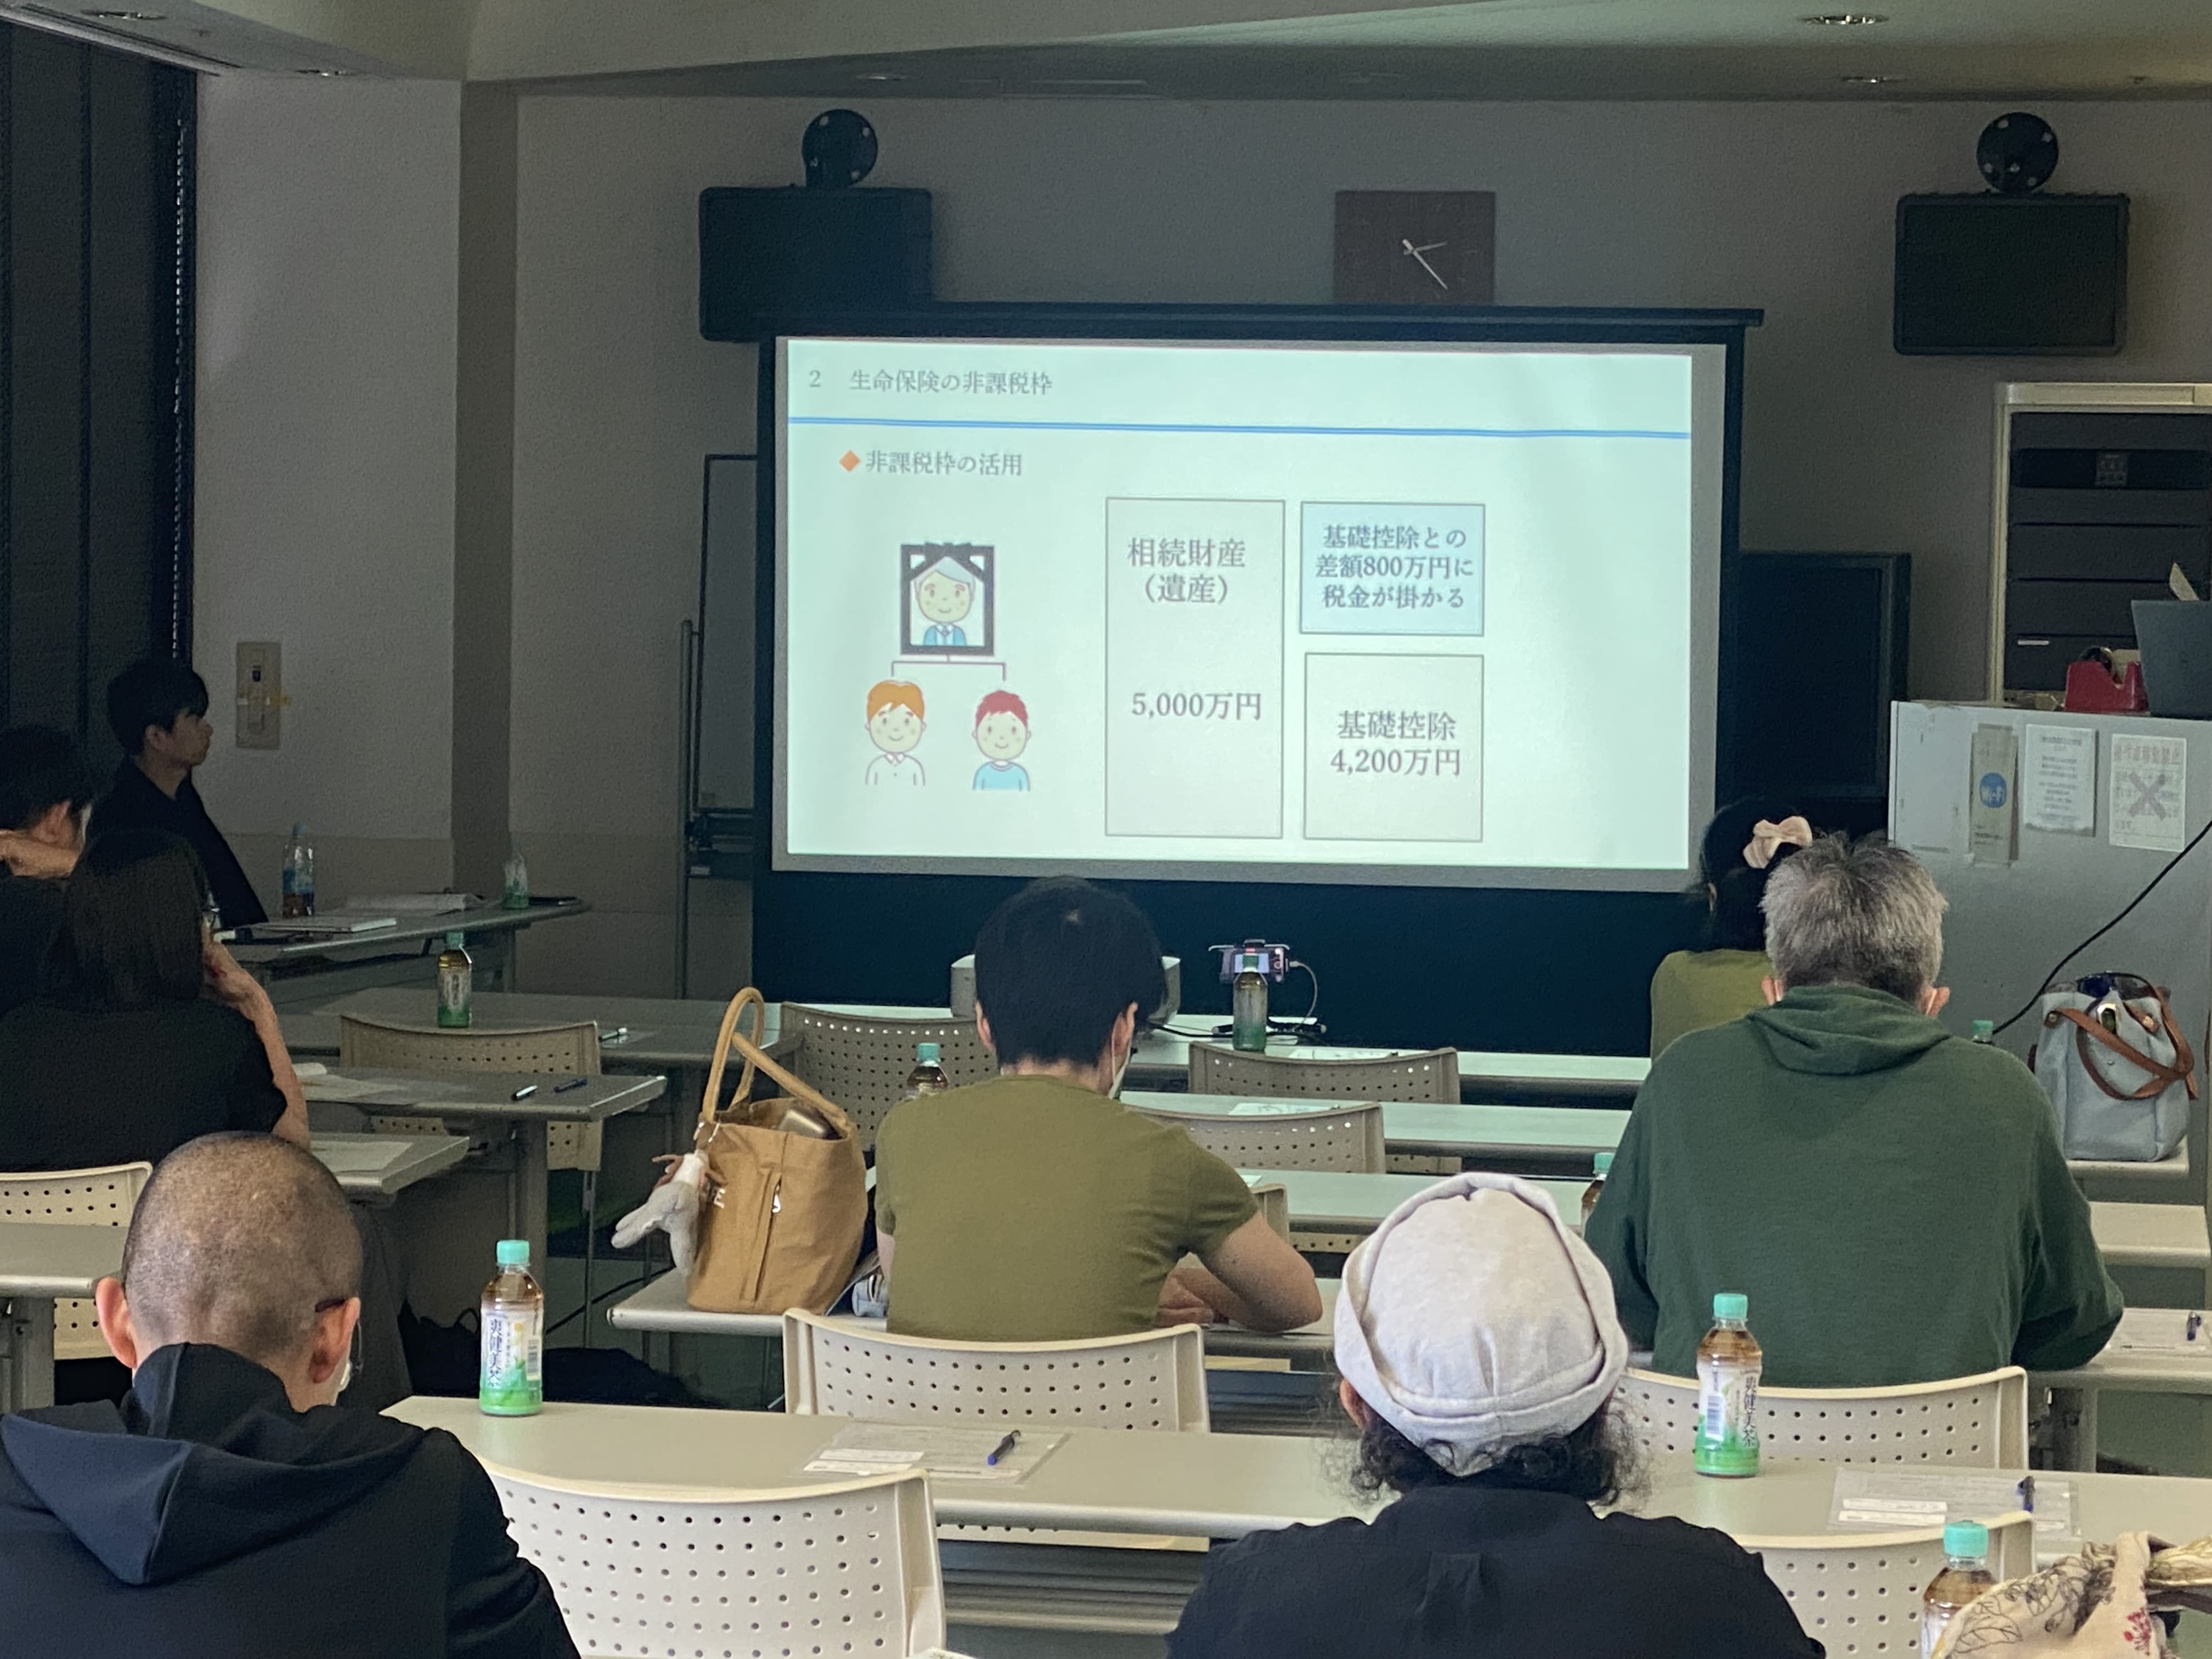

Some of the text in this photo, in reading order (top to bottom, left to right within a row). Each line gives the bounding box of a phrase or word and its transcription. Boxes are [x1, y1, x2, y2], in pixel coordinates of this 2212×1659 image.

[809, 369, 1052, 395] 2 生命保険の非課税枠
[866, 450, 1022, 476] 非課税枠の活用
[1323, 524, 1466, 550] 基礎控除との
[1127, 537, 1246, 568] 相続財産
[1315, 554, 1474, 580] 差額800万円に
[1322, 584, 1465, 610] 税金が掛かる
[1131, 692, 1262, 721] 5,000万円
[1337, 710, 1457, 741] 基礎控除
[1330, 748, 1460, 777] 4,200万円
